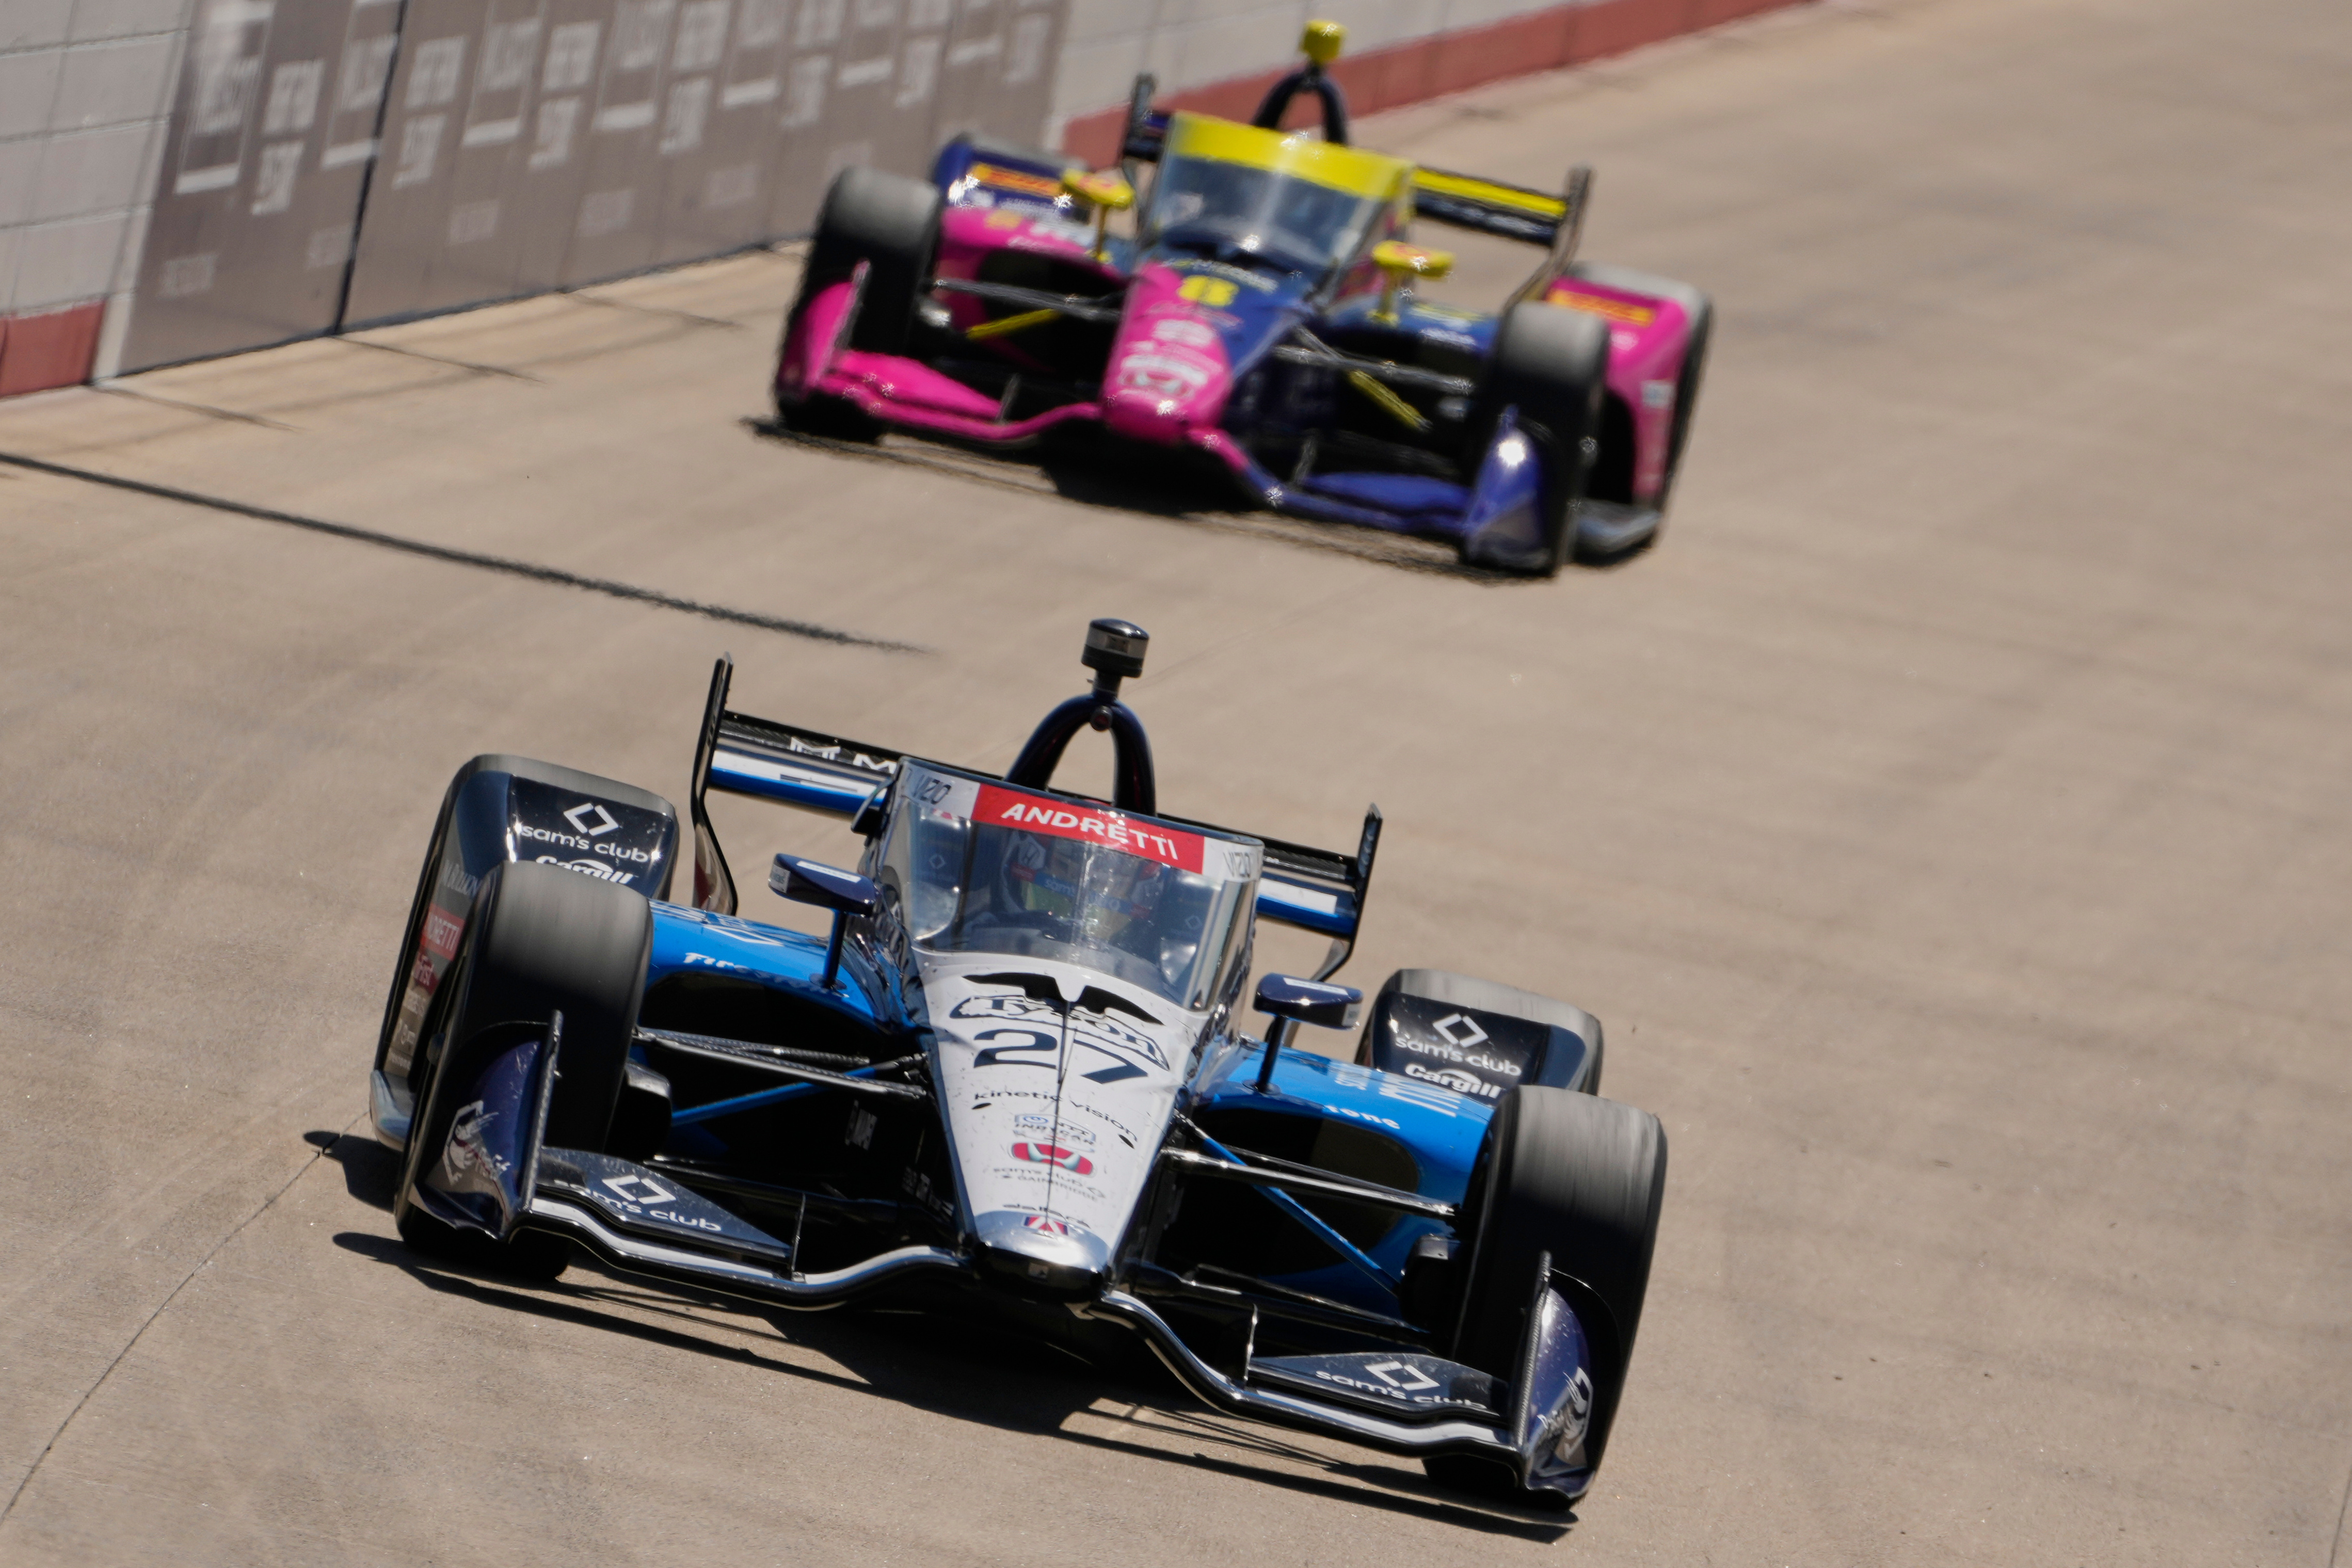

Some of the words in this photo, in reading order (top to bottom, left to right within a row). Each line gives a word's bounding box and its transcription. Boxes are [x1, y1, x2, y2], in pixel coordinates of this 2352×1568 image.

[521, 825, 590, 850] sam's
[595, 842, 649, 863] club
[1001, 803, 1179, 860] ANDRETTI
[974, 1029, 1149, 1084] 27
[1395, 1036, 1464, 1063] sam's
[1466, 1054, 1522, 1077] club
[1404, 1062, 1502, 1099] Cargill
[974, 1090, 1062, 1102] kinetic
[1070, 1099, 1138, 1142] vision
[649, 1209, 722, 1231] club
[1316, 1370, 1407, 1400] sam's
